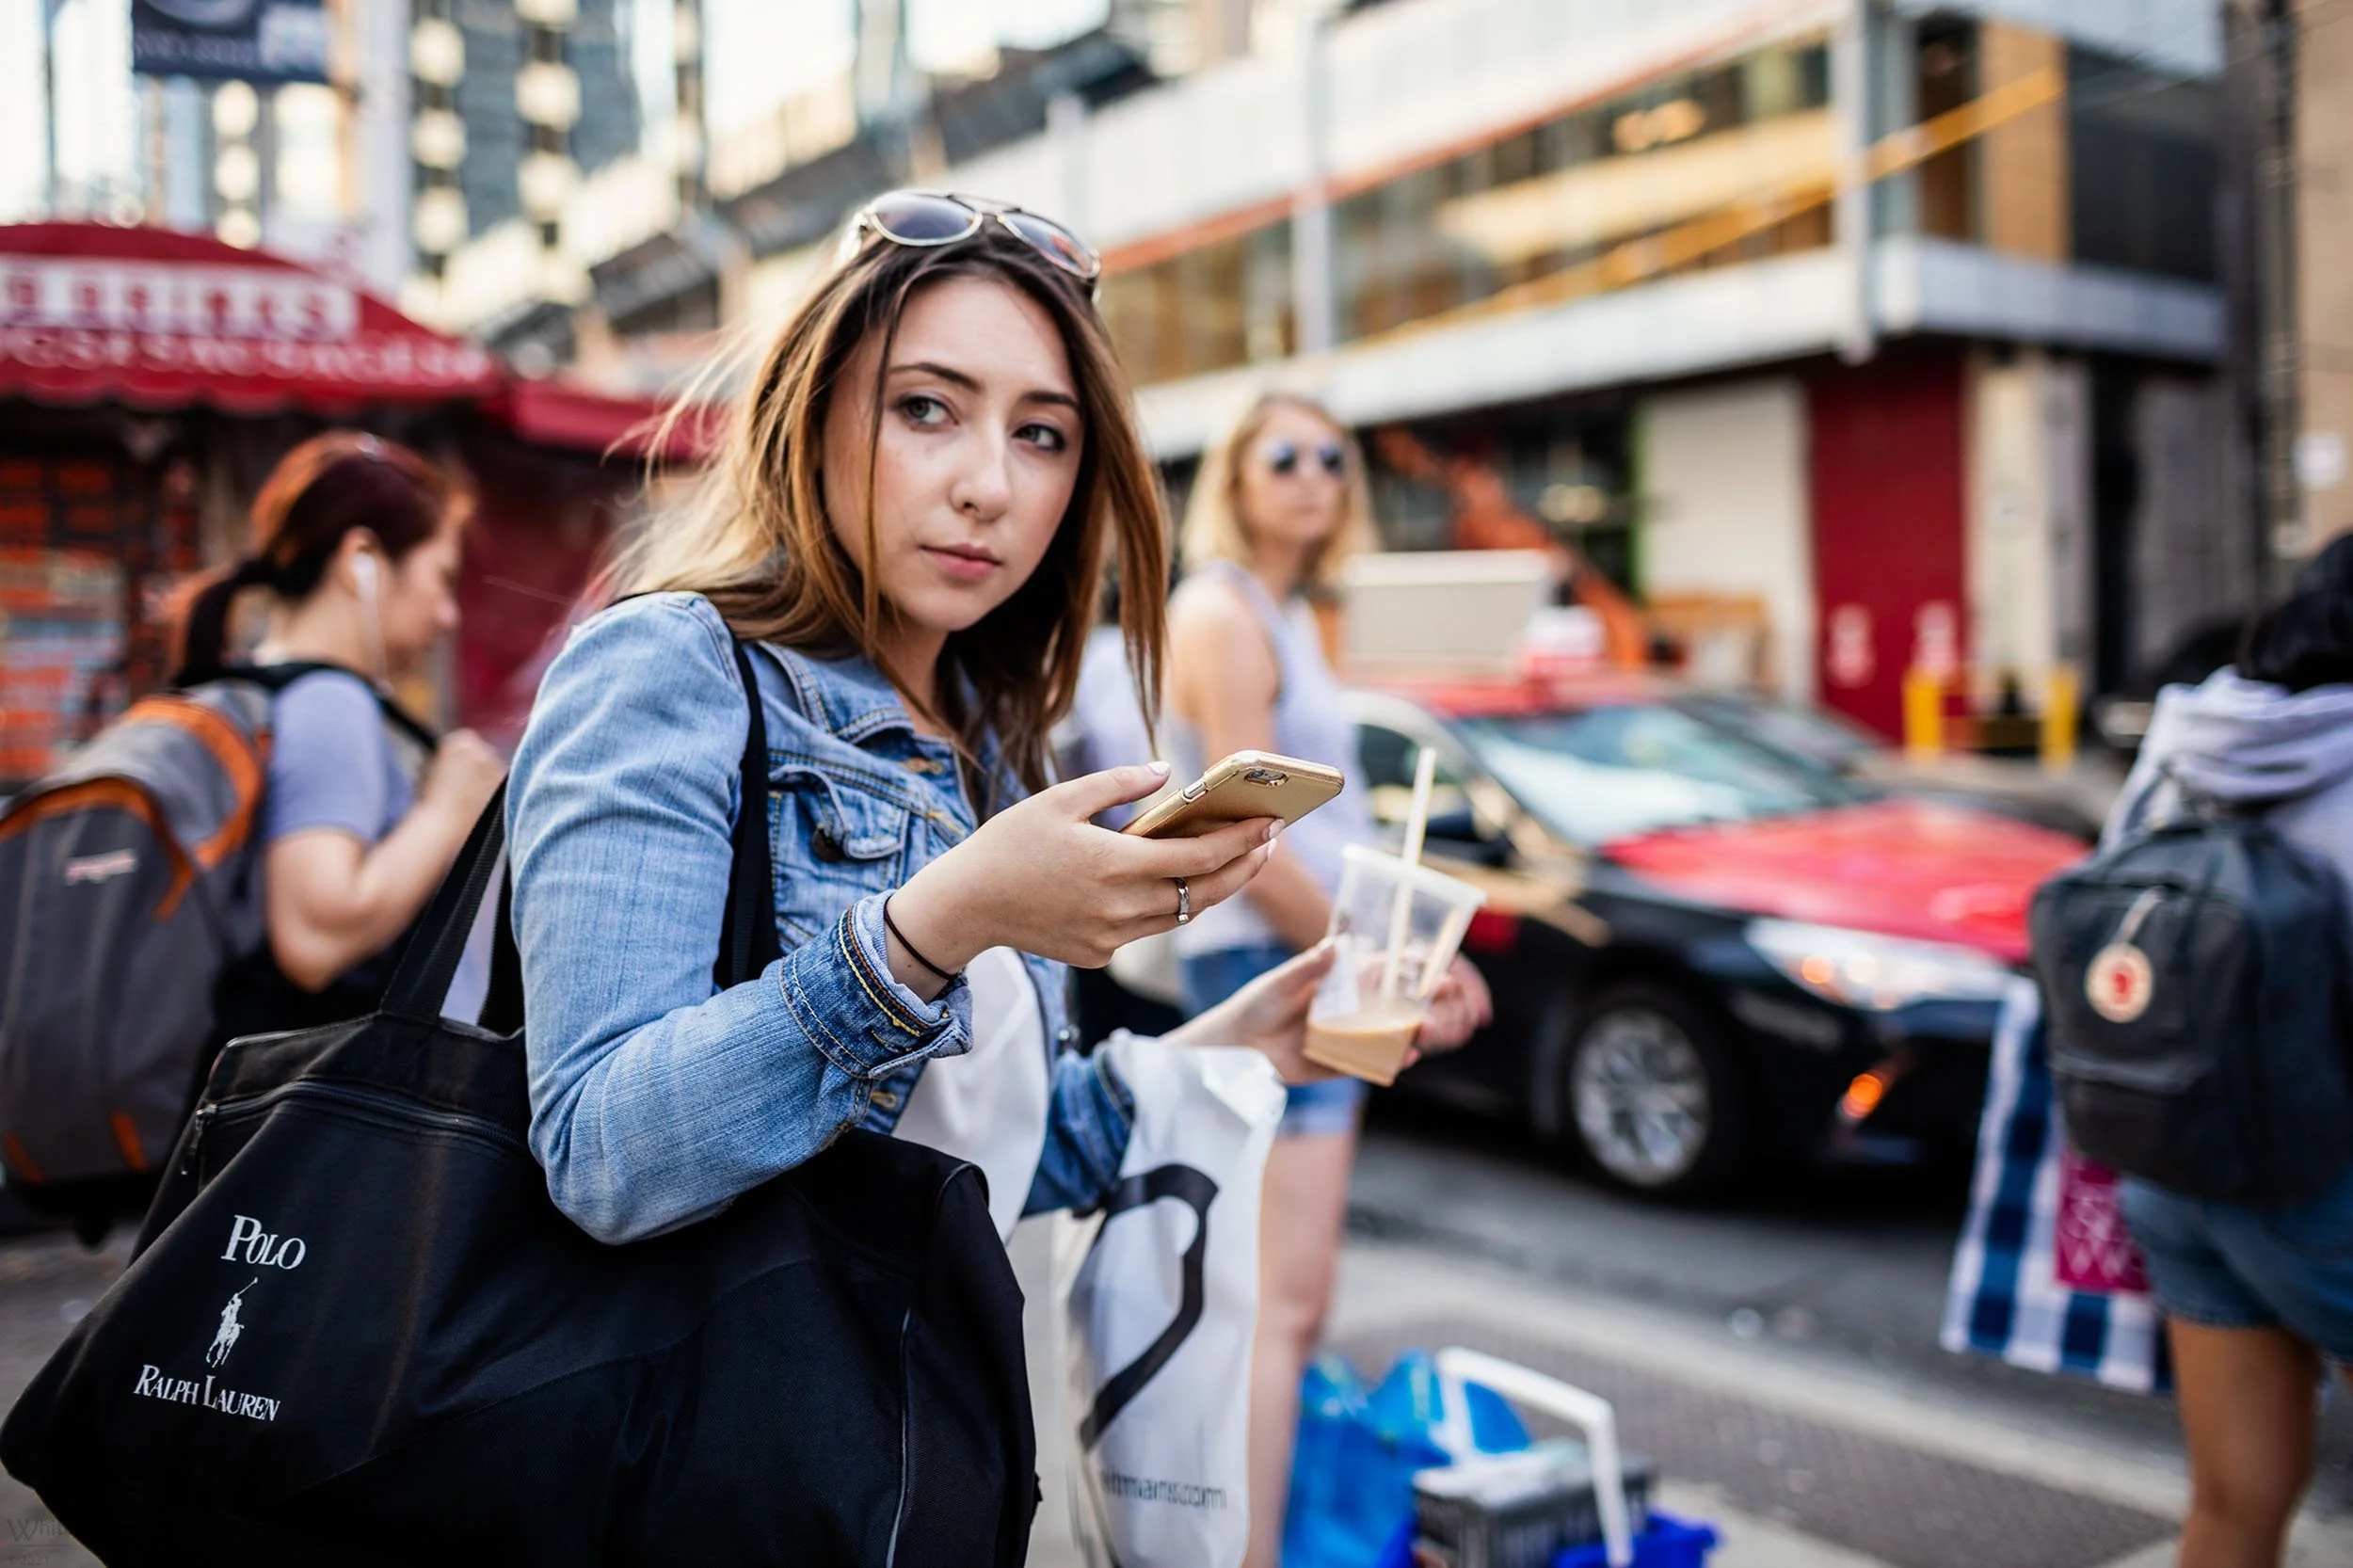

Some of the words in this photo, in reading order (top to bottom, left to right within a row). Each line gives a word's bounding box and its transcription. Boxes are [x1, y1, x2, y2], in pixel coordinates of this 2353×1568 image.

[220, 1214, 307, 1270] POLO
[133, 1364, 200, 1405] RALPH
[201, 1374, 281, 1422] LAUREN
